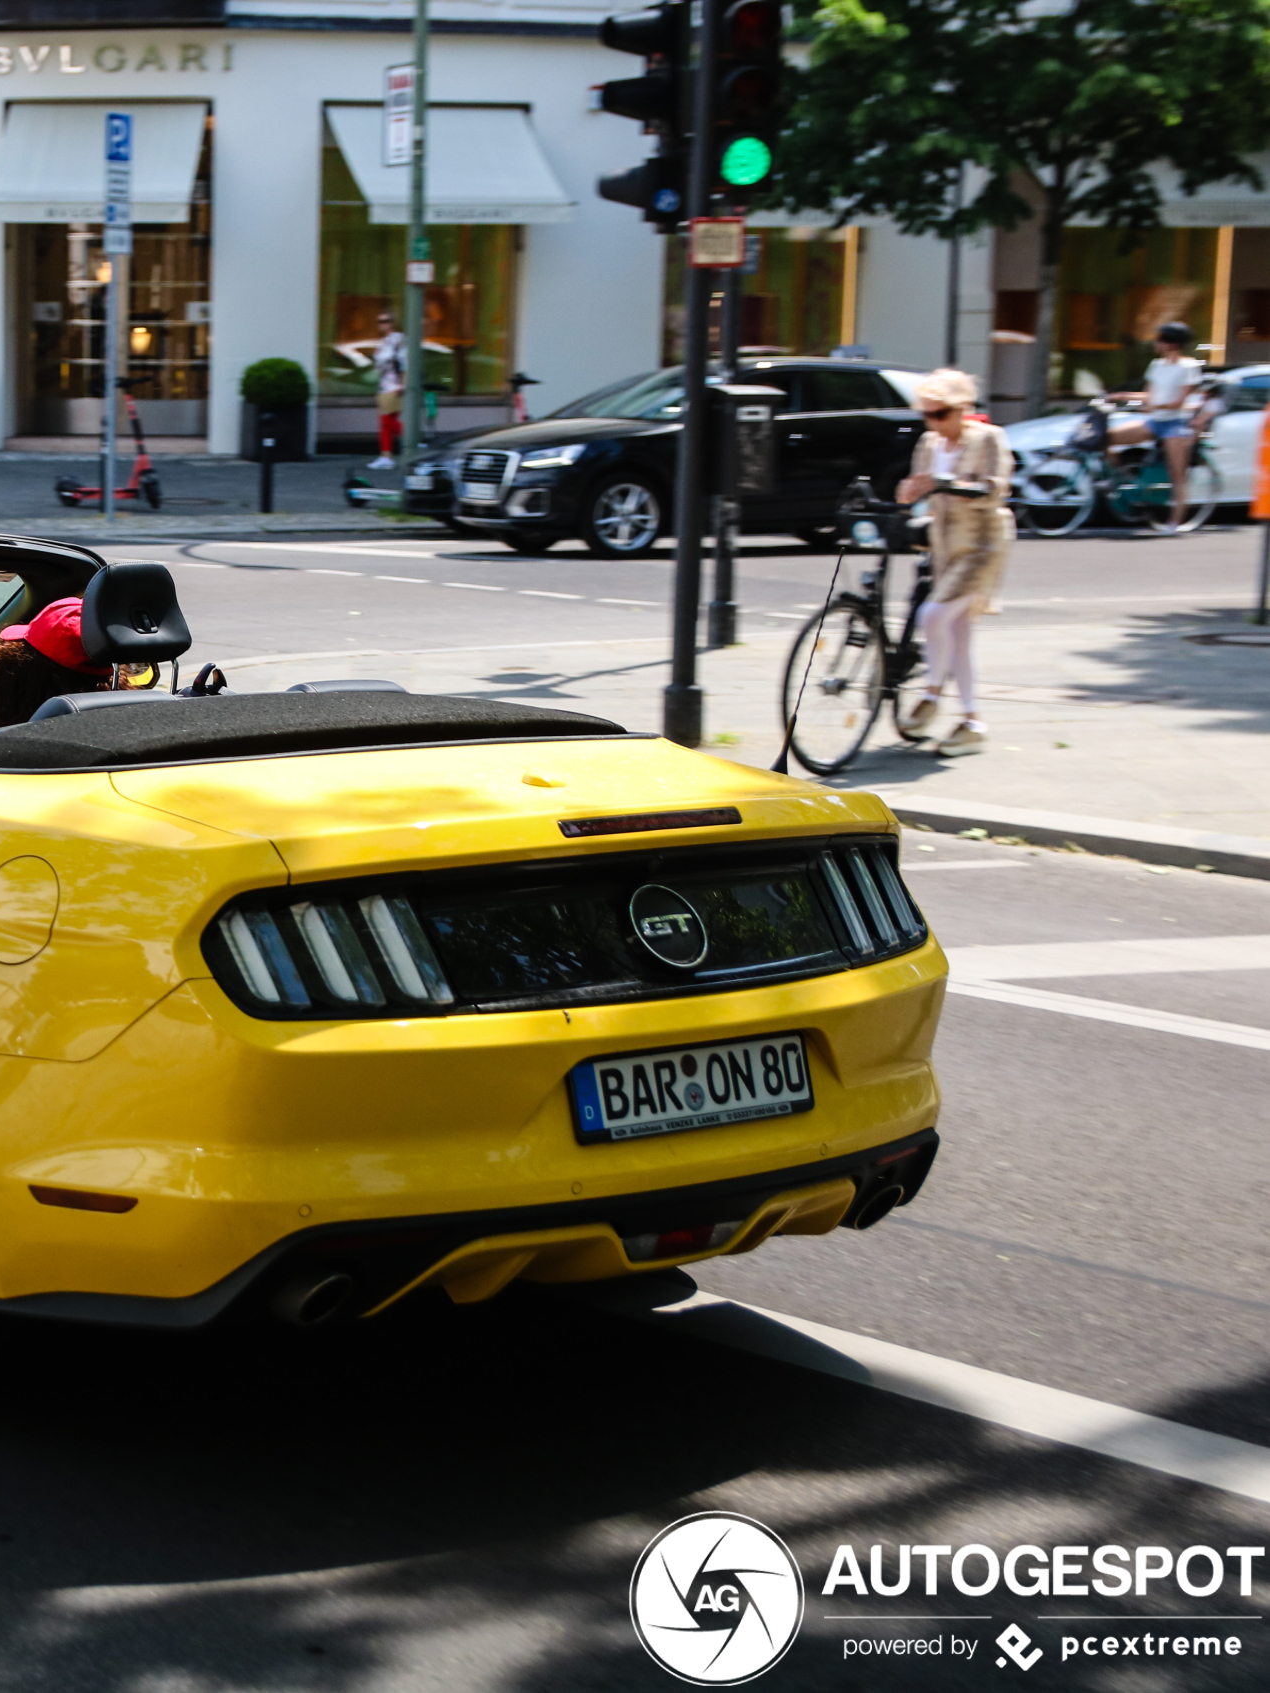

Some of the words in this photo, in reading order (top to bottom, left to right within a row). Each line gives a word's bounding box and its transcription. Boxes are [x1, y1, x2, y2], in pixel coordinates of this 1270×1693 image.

[641, 913, 692, 937] GT
[599, 1060, 683, 1120] BAR
[706, 1048, 756, 1105] ON
[760, 1042, 805, 1096] 80
[584, 1104, 595, 1120] D
[630, 1122, 662, 1135] Autohaus
[665, 1117, 694, 1130] VENZKE
[696, 1113, 721, 1126] LANKE
